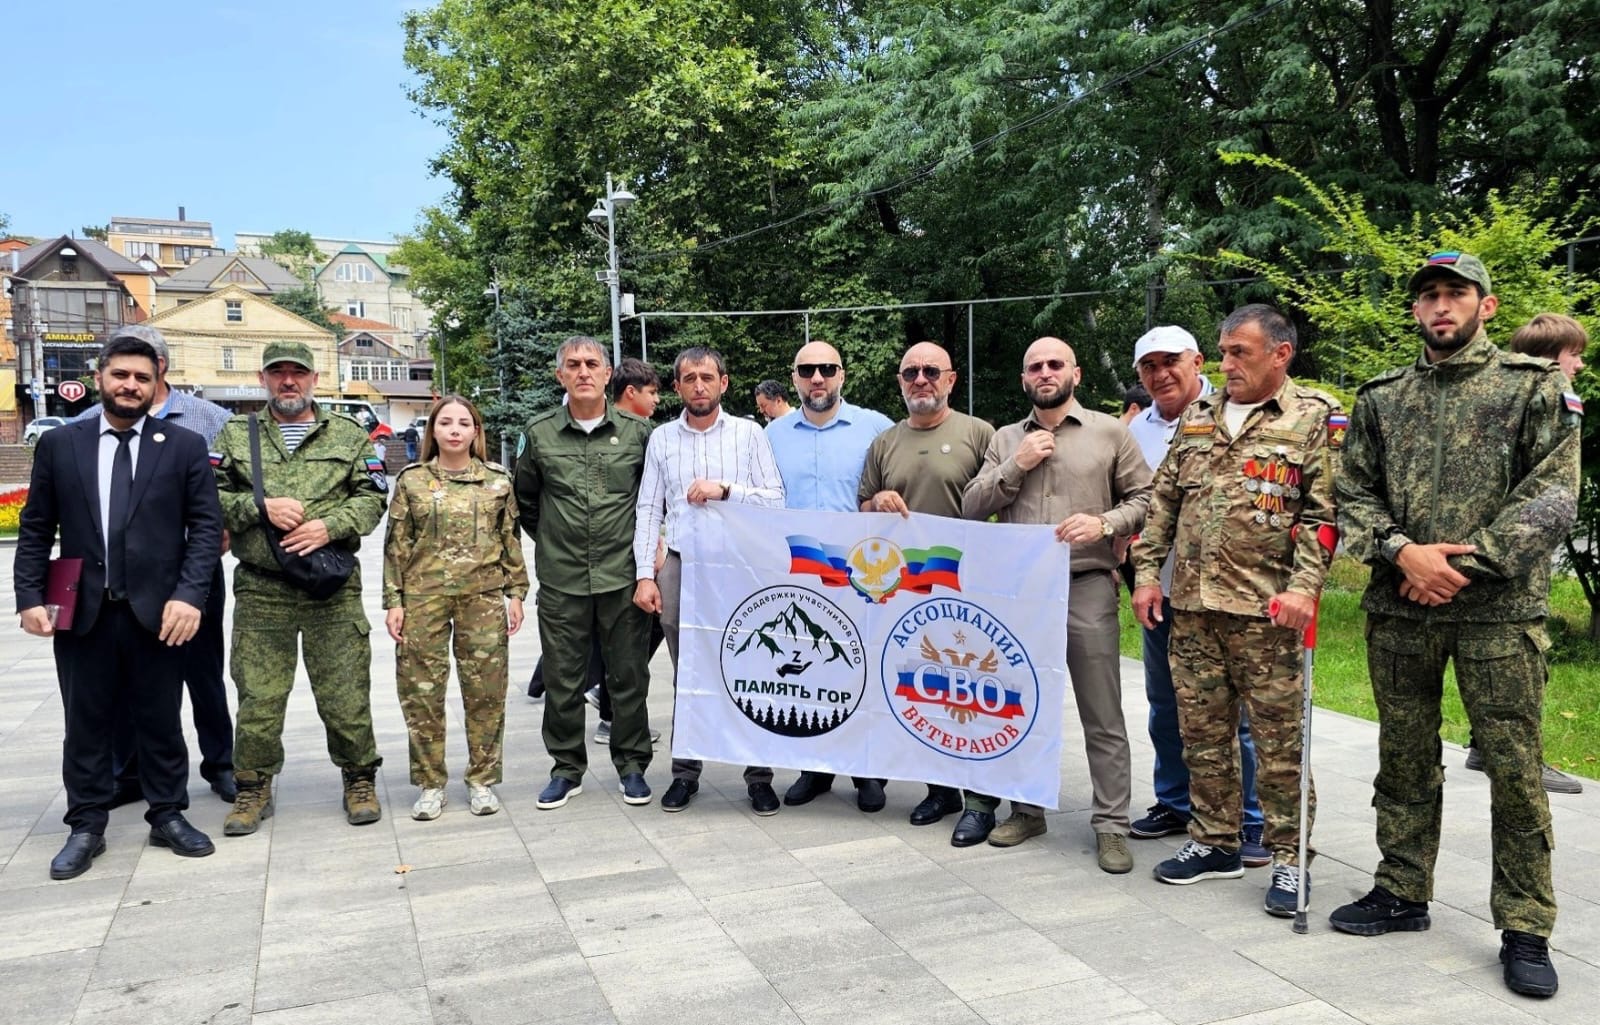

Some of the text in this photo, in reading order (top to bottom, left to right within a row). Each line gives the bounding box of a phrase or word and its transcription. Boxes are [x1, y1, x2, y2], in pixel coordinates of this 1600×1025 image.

[726, 591, 862, 665] ДРОО поддержки участников СВО
[892, 602, 1025, 667] АССОЦИАЦИЯ
[792, 650, 802, 663] Z
[734, 679, 851, 704] ПАМЯТЬ ГОР
[913, 662, 1006, 713] СВО
[902, 705, 1020, 754] ВЕТЕРАНОВ
